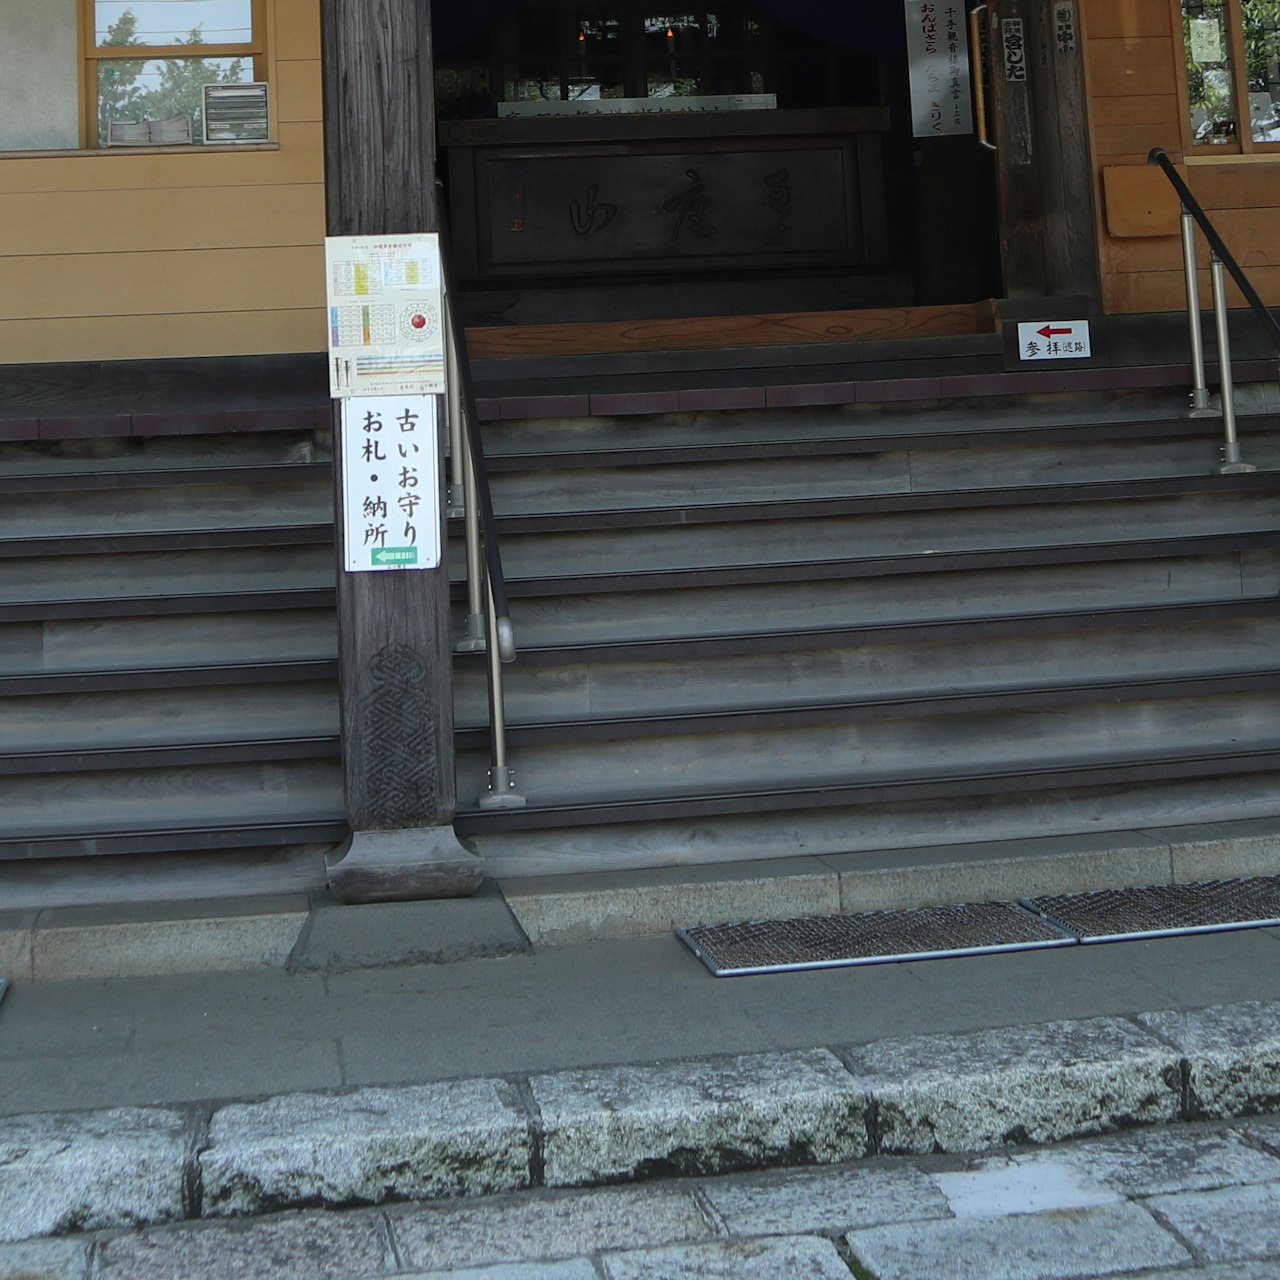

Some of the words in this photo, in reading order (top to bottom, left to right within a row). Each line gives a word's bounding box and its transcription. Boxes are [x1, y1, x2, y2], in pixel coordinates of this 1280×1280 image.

[361, 409, 389, 548] お札・納所
[396, 408, 421, 548] 古いお守り
